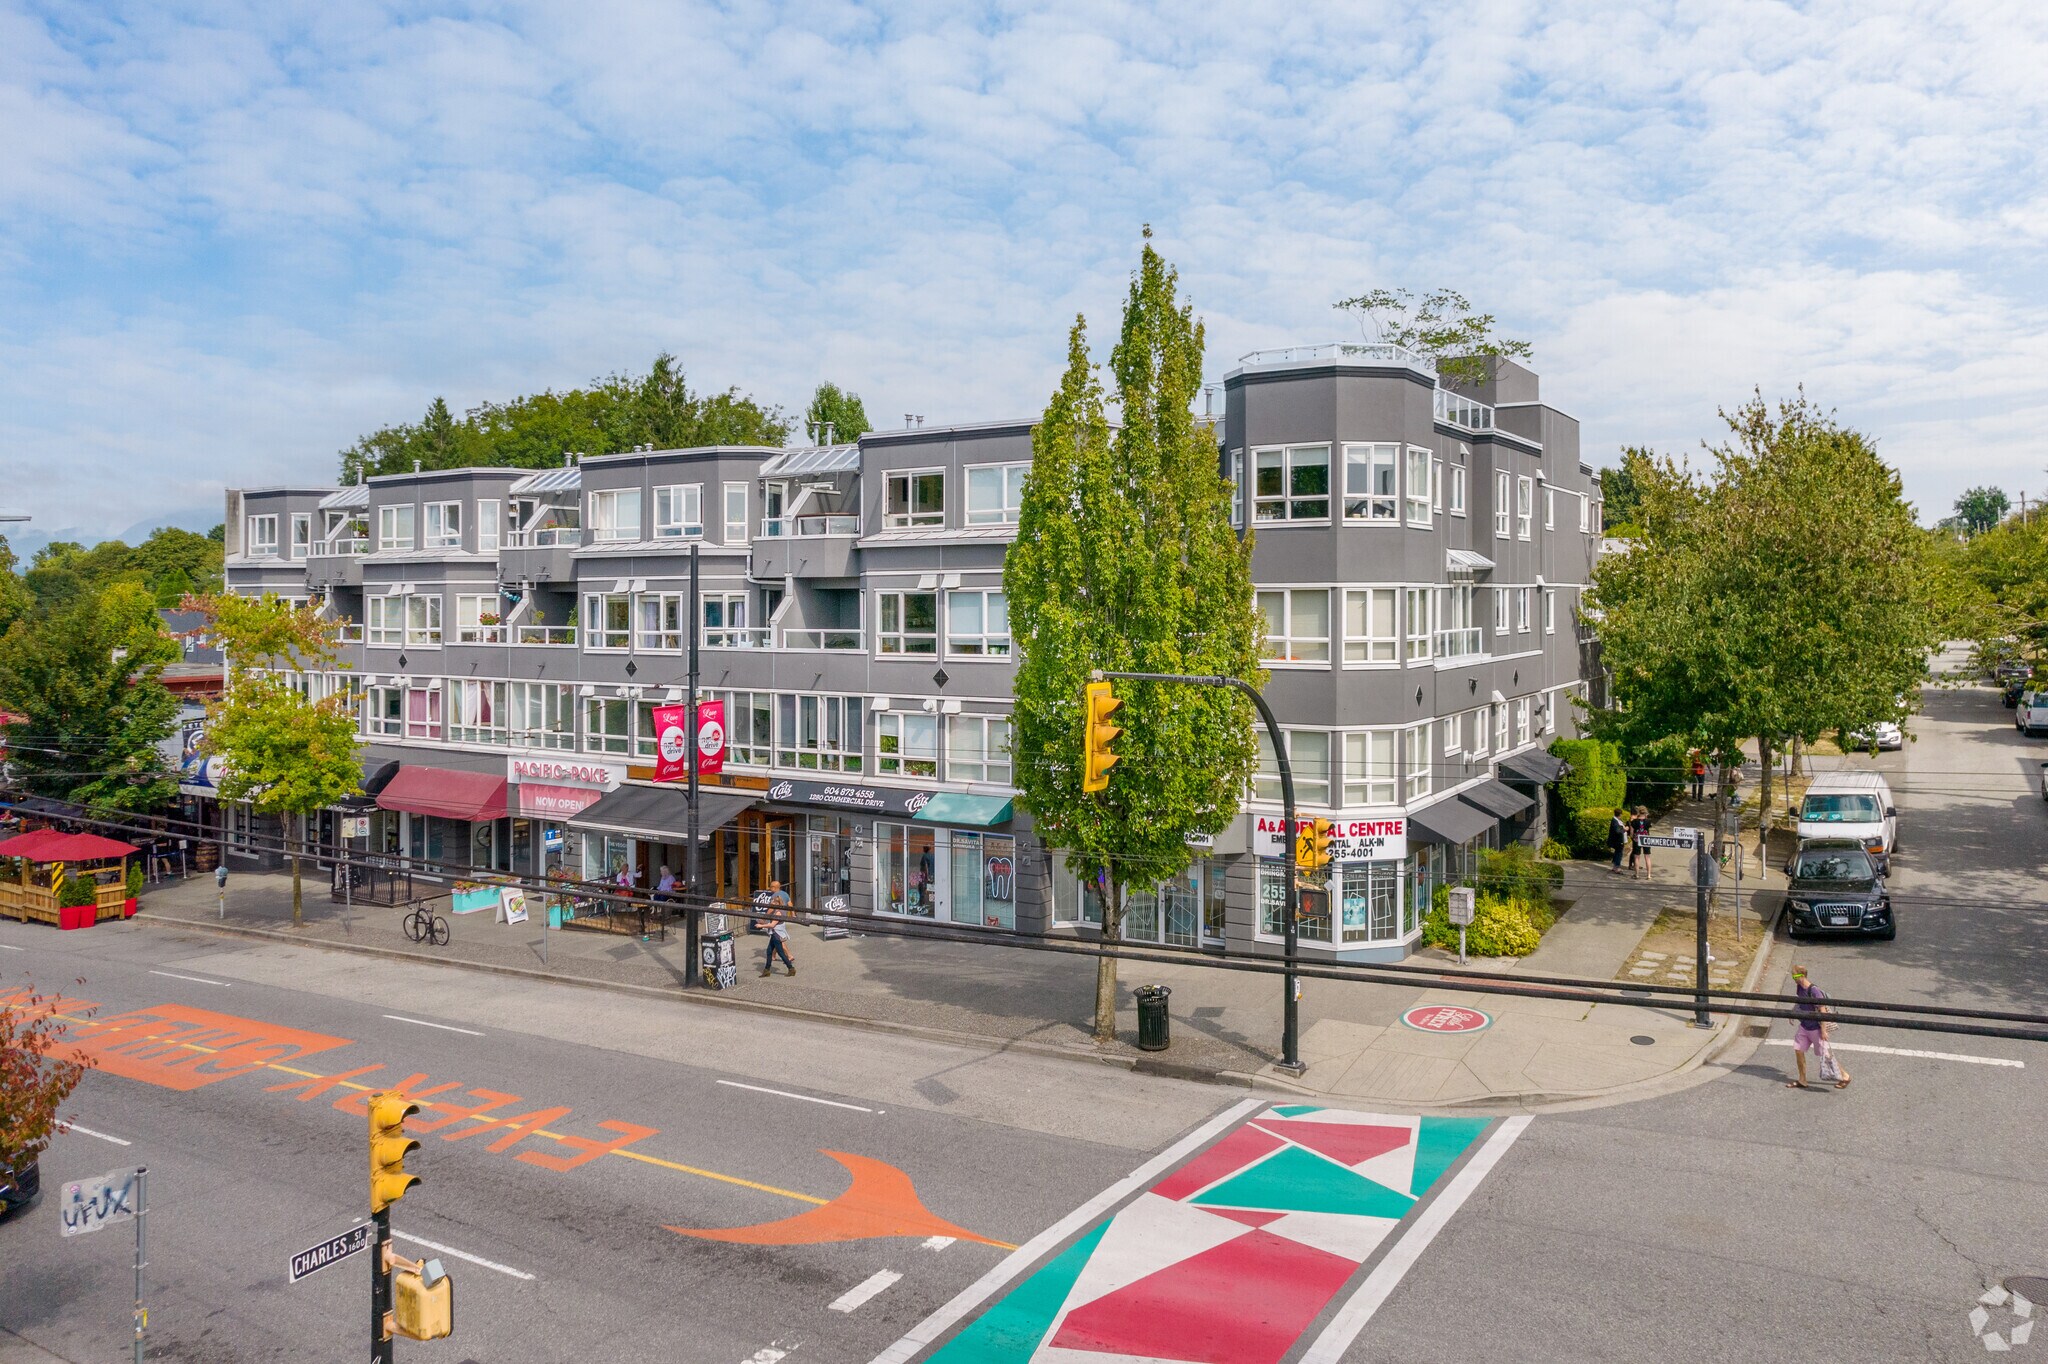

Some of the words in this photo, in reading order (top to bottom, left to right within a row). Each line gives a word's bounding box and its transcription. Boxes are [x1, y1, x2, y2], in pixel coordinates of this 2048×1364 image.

[663, 713, 678, 724] Love
[703, 708, 717, 719] Love
[824, 787, 840, 795] 604
[840, 788, 855, 796] 873
[536, 797, 556, 807] NOW
[558, 800, 584, 810] OPEN!
[824, 795, 864, 805] COMMERCIAL
[1350, 820, 1403, 837] CENTRE
[1643, 837, 1679, 847] COMMERCIAL
[348, 1239, 365, 1252] 1600
[295, 1237, 347, 1275] CHARLES
[354, 1229, 363, 1240] ST
